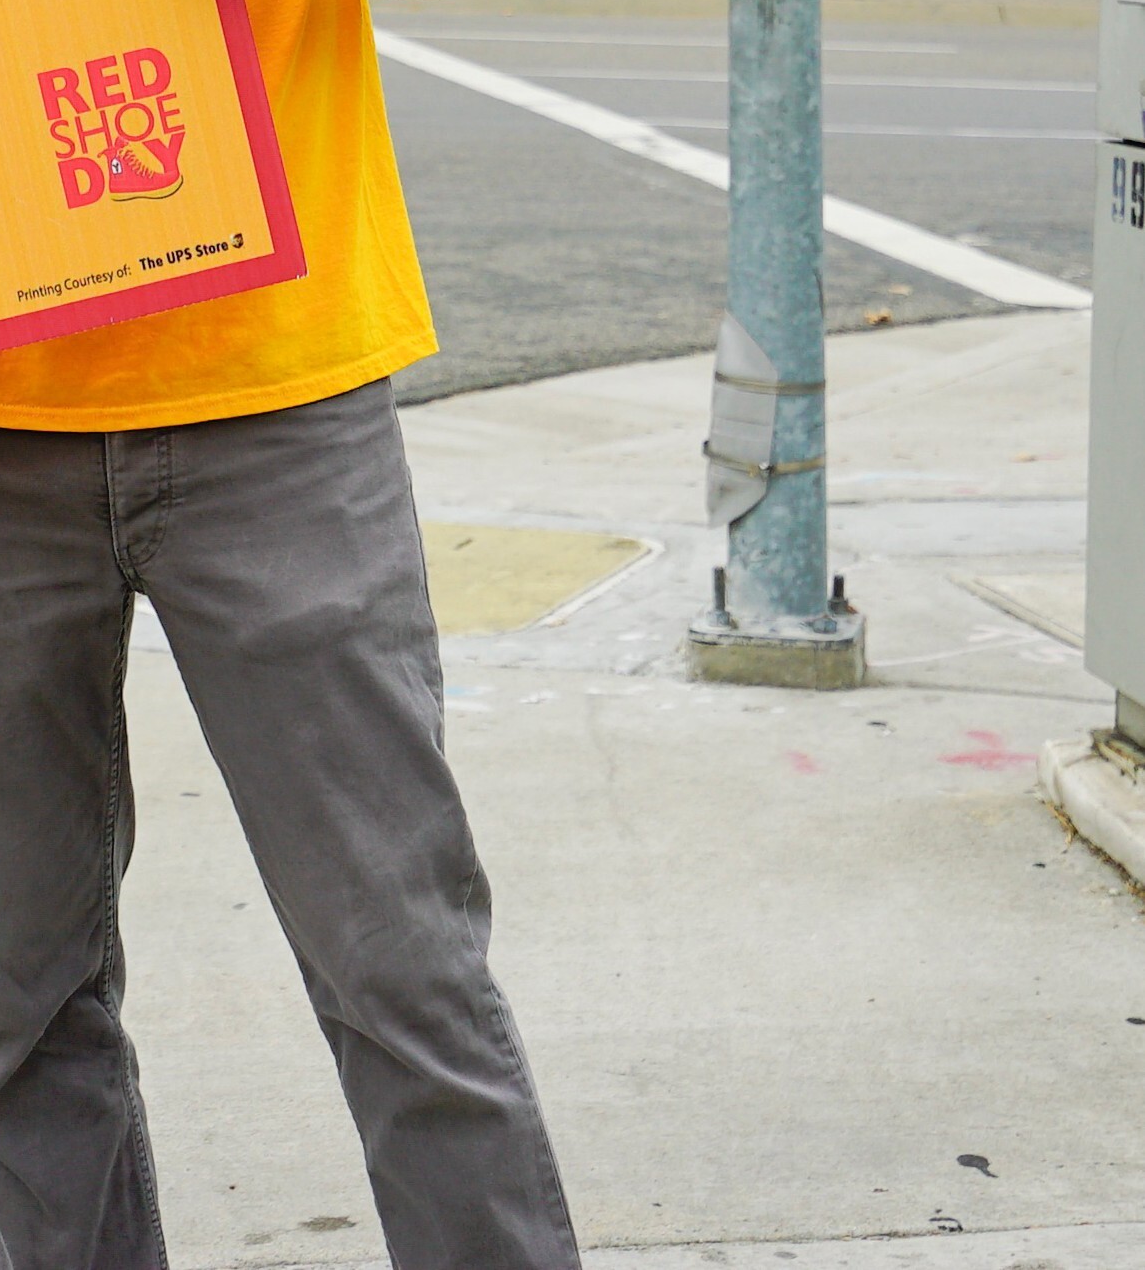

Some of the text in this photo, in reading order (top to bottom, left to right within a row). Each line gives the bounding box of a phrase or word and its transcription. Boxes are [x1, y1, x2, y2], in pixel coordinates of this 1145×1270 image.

[37, 47, 172, 121] RED
[50, 92, 186, 159] SHOE
[17, 283, 63, 303] Printing
[63, 270, 114, 291] Courtesy
[115, 263, 132, 278] of:
[139, 257, 164, 272] The
[166, 247, 193, 265] UPS
[195, 239, 229, 258] Store
